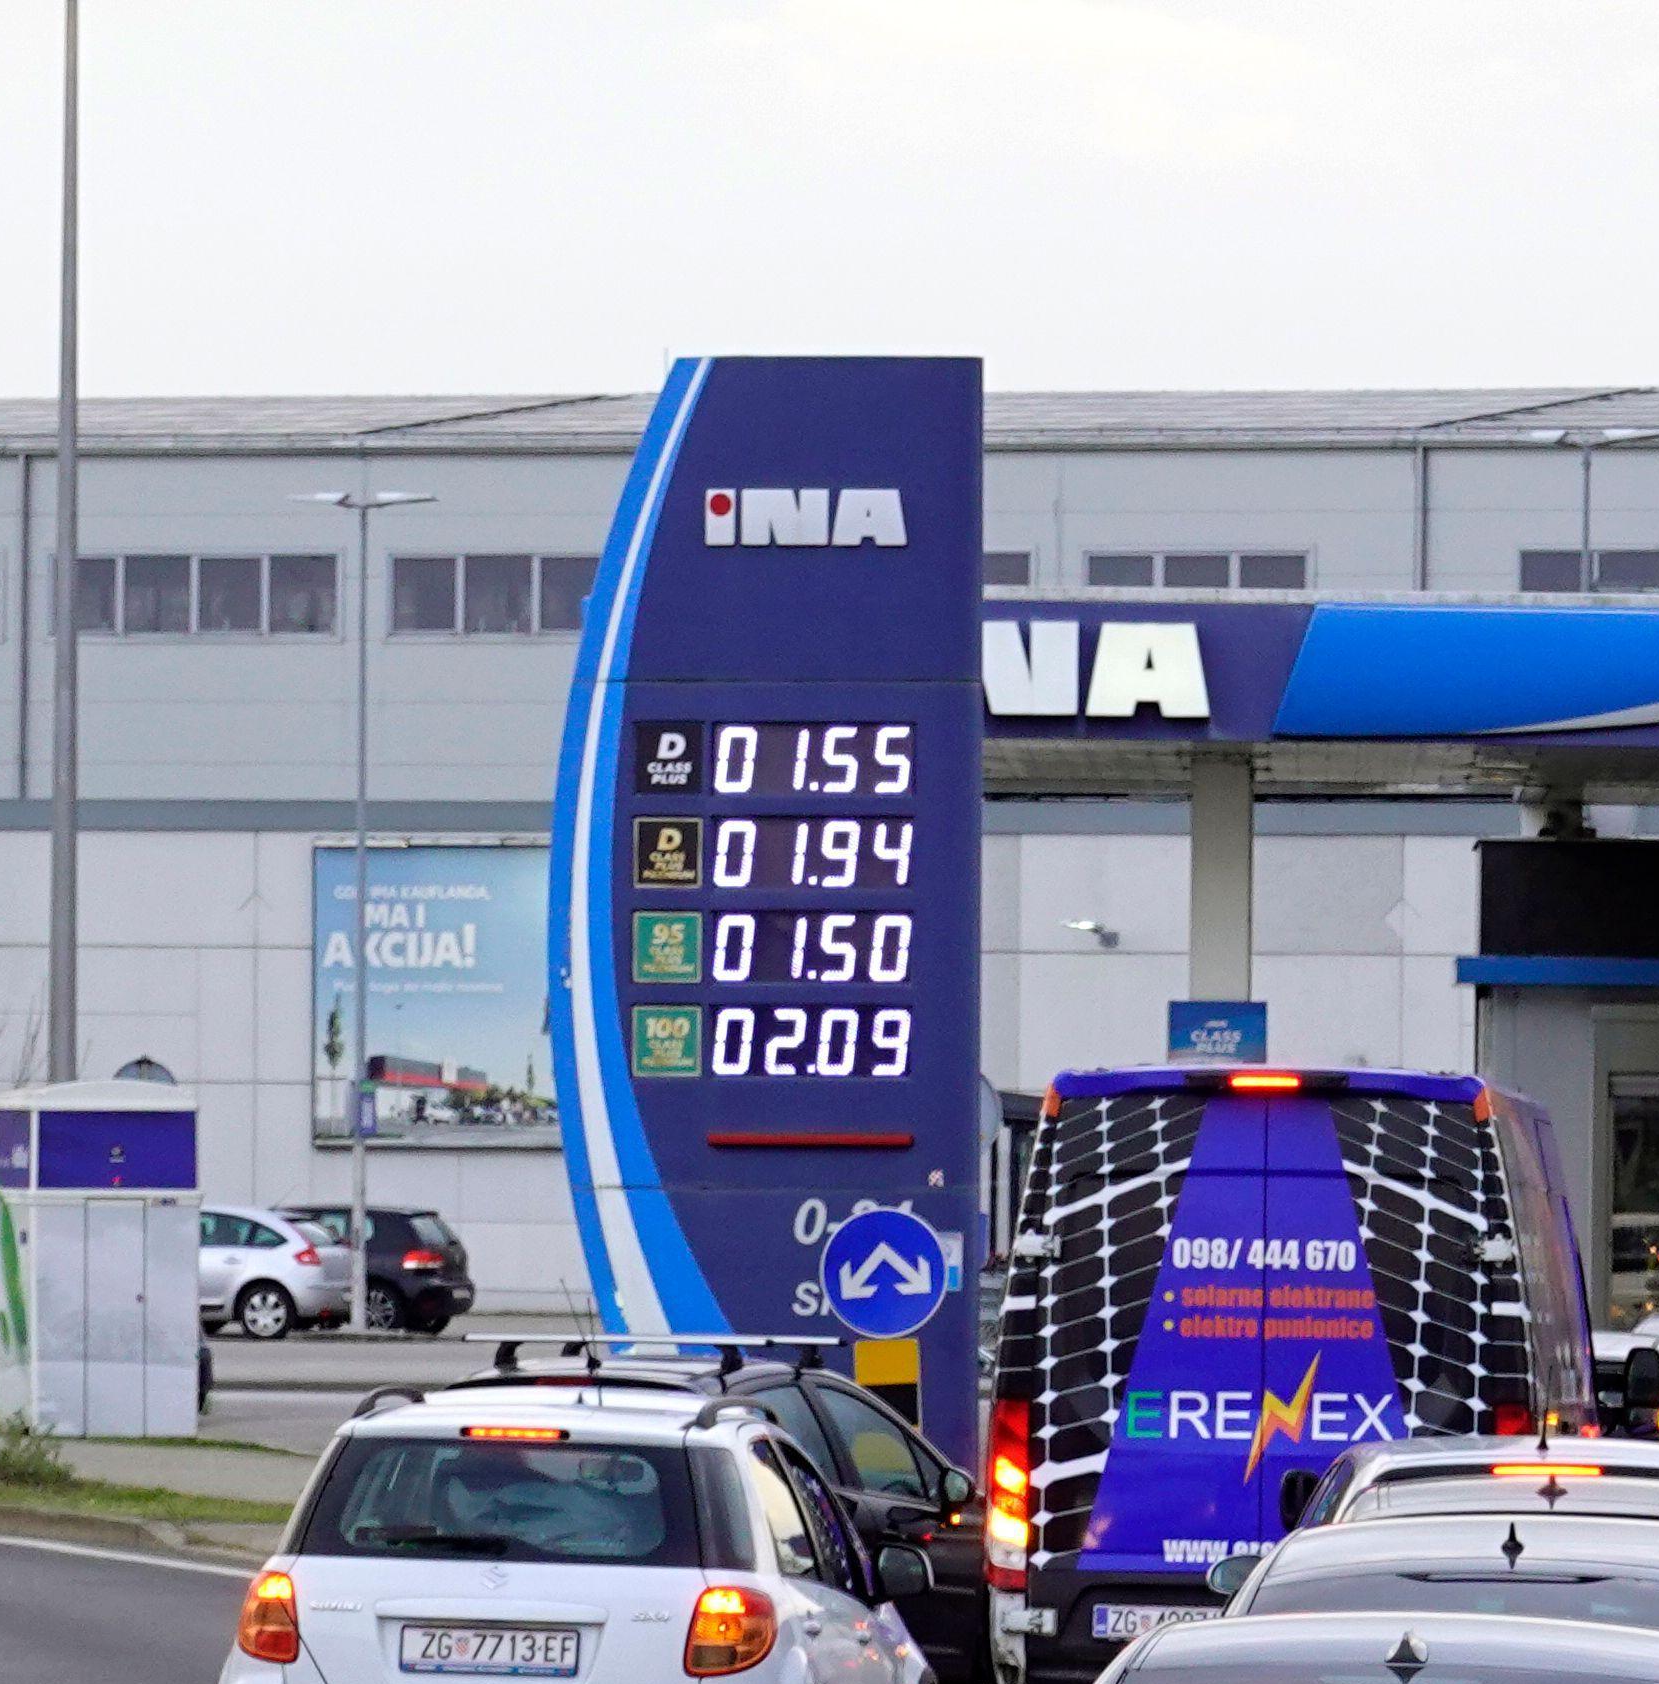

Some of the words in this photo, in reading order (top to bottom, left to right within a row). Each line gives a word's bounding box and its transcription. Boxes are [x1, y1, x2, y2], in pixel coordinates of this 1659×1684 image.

[982, 620, 1209, 718] NA
[656, 732, 687, 759] D
[647, 761, 692, 774] CLASS
[650, 773, 688, 785] PLUS
[656, 827, 683, 851] D
[364, 902, 410, 929] MA
[652, 923, 685, 945] 95
[645, 1017, 691, 1038] 100
[1172, 1237, 1243, 1270] 098/
[1247, 1238, 1300, 1270] 444
[1305, 1239, 1356, 1271] 670
[1181, 1285, 1264, 1307] solarne
[1269, 1285, 1375, 1309] elektrane
[1180, 1315, 1258, 1338] elektro
[1263, 1316, 1375, 1340] punionice
[1126, 1381, 1394, 1458] ERENEX
[1111, 1611, 1138, 1634] ZG
[421, 1632, 453, 1660] ZG
